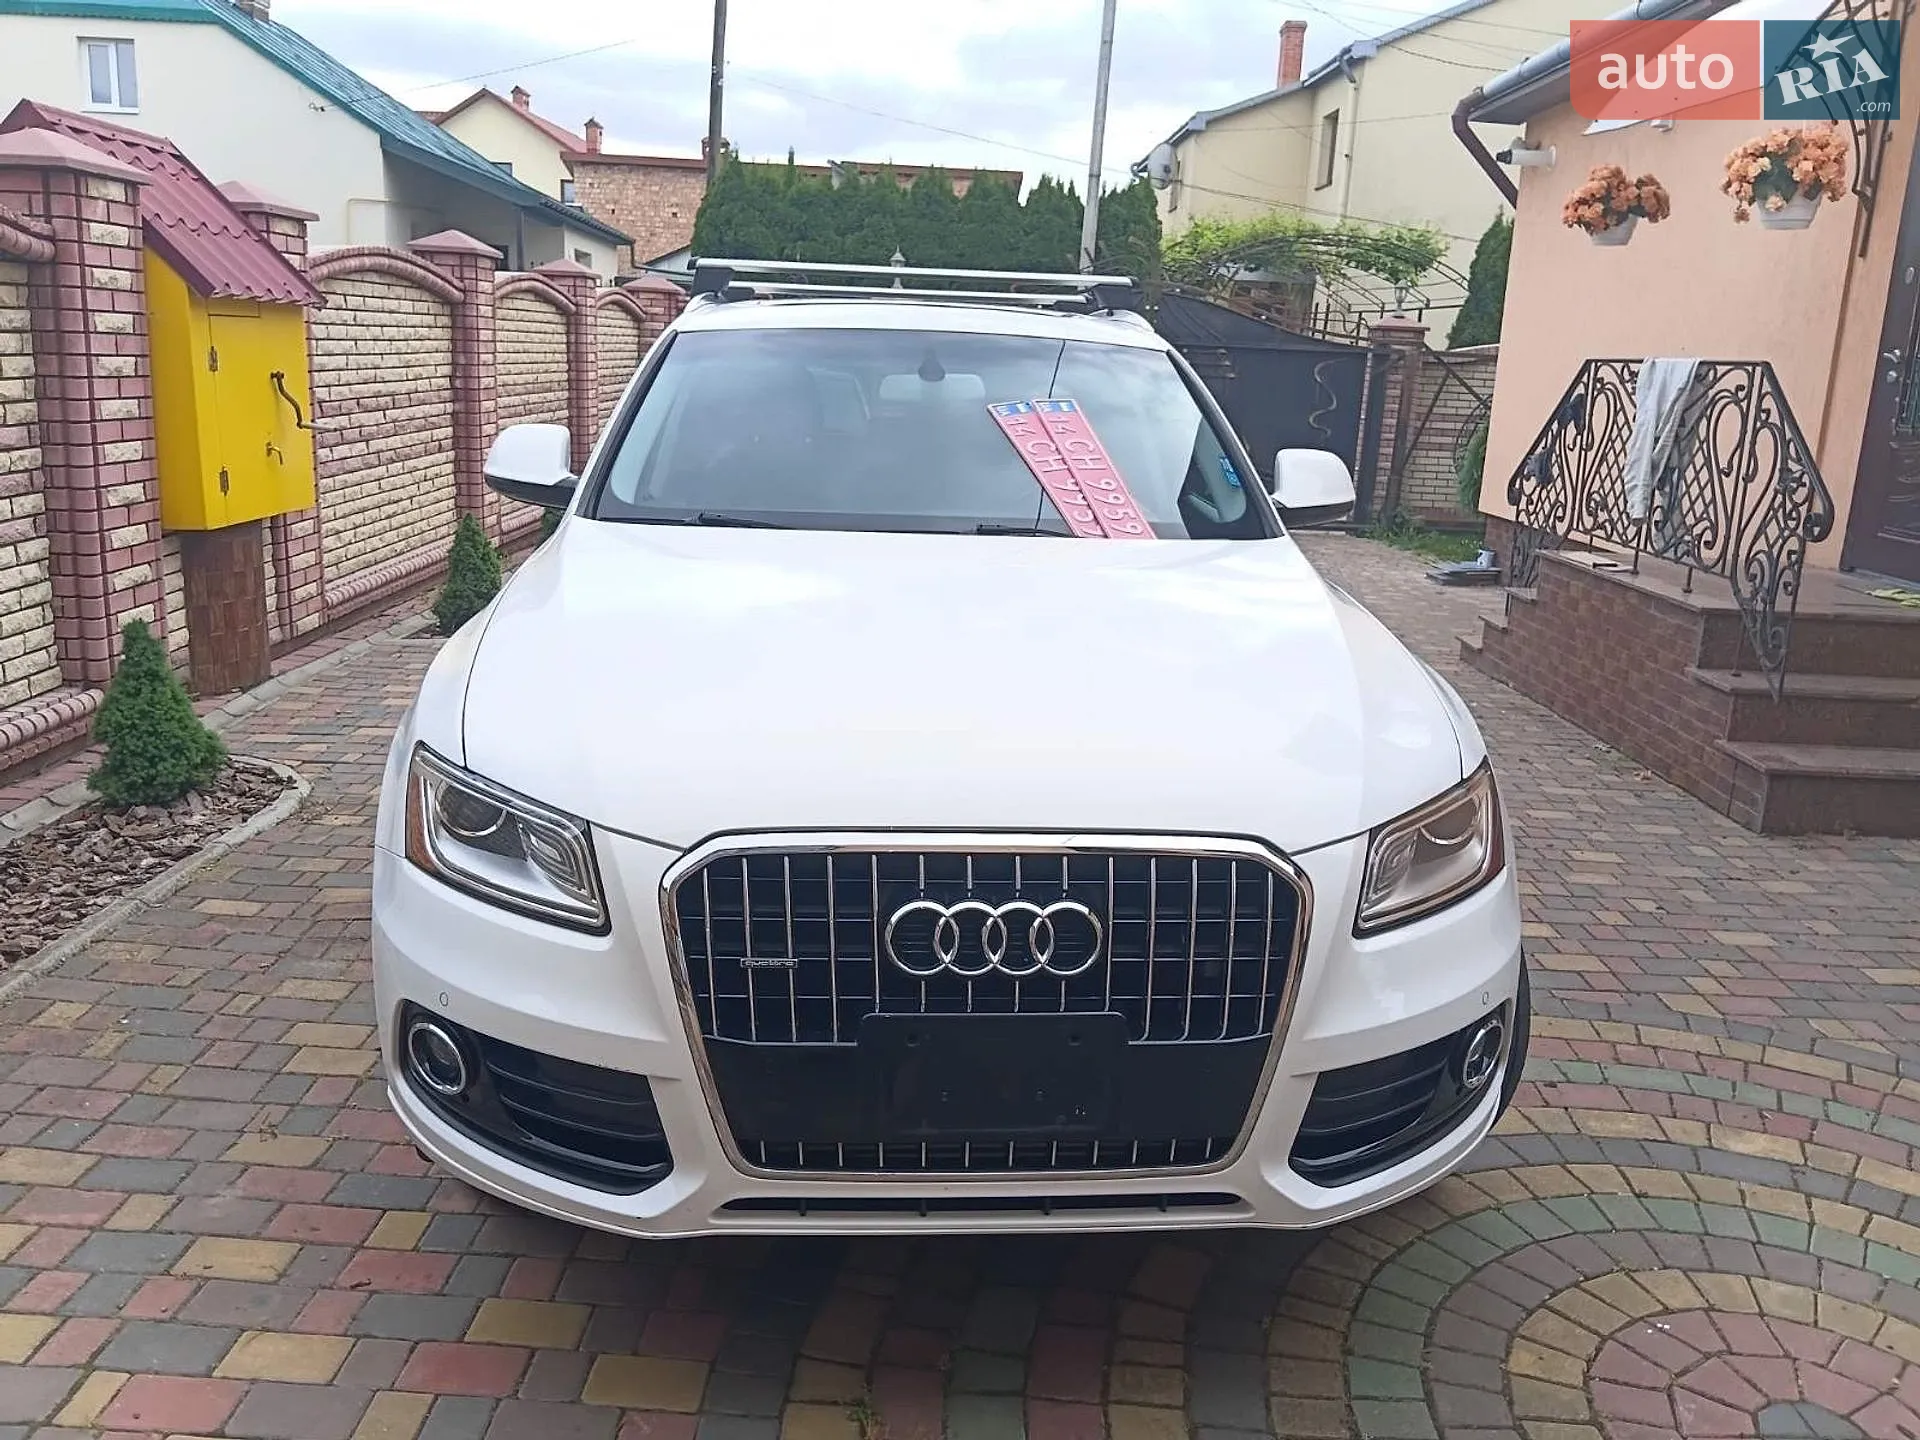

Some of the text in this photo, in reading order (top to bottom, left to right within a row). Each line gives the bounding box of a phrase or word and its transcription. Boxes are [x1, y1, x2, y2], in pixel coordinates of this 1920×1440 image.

[1006, 416, 1037, 437] 14
[1025, 440, 1068, 473] CH
[1047, 416, 1078, 435] 14
[1064, 440, 1107, 471] CH
[1083, 478, 1144, 535] 9959
